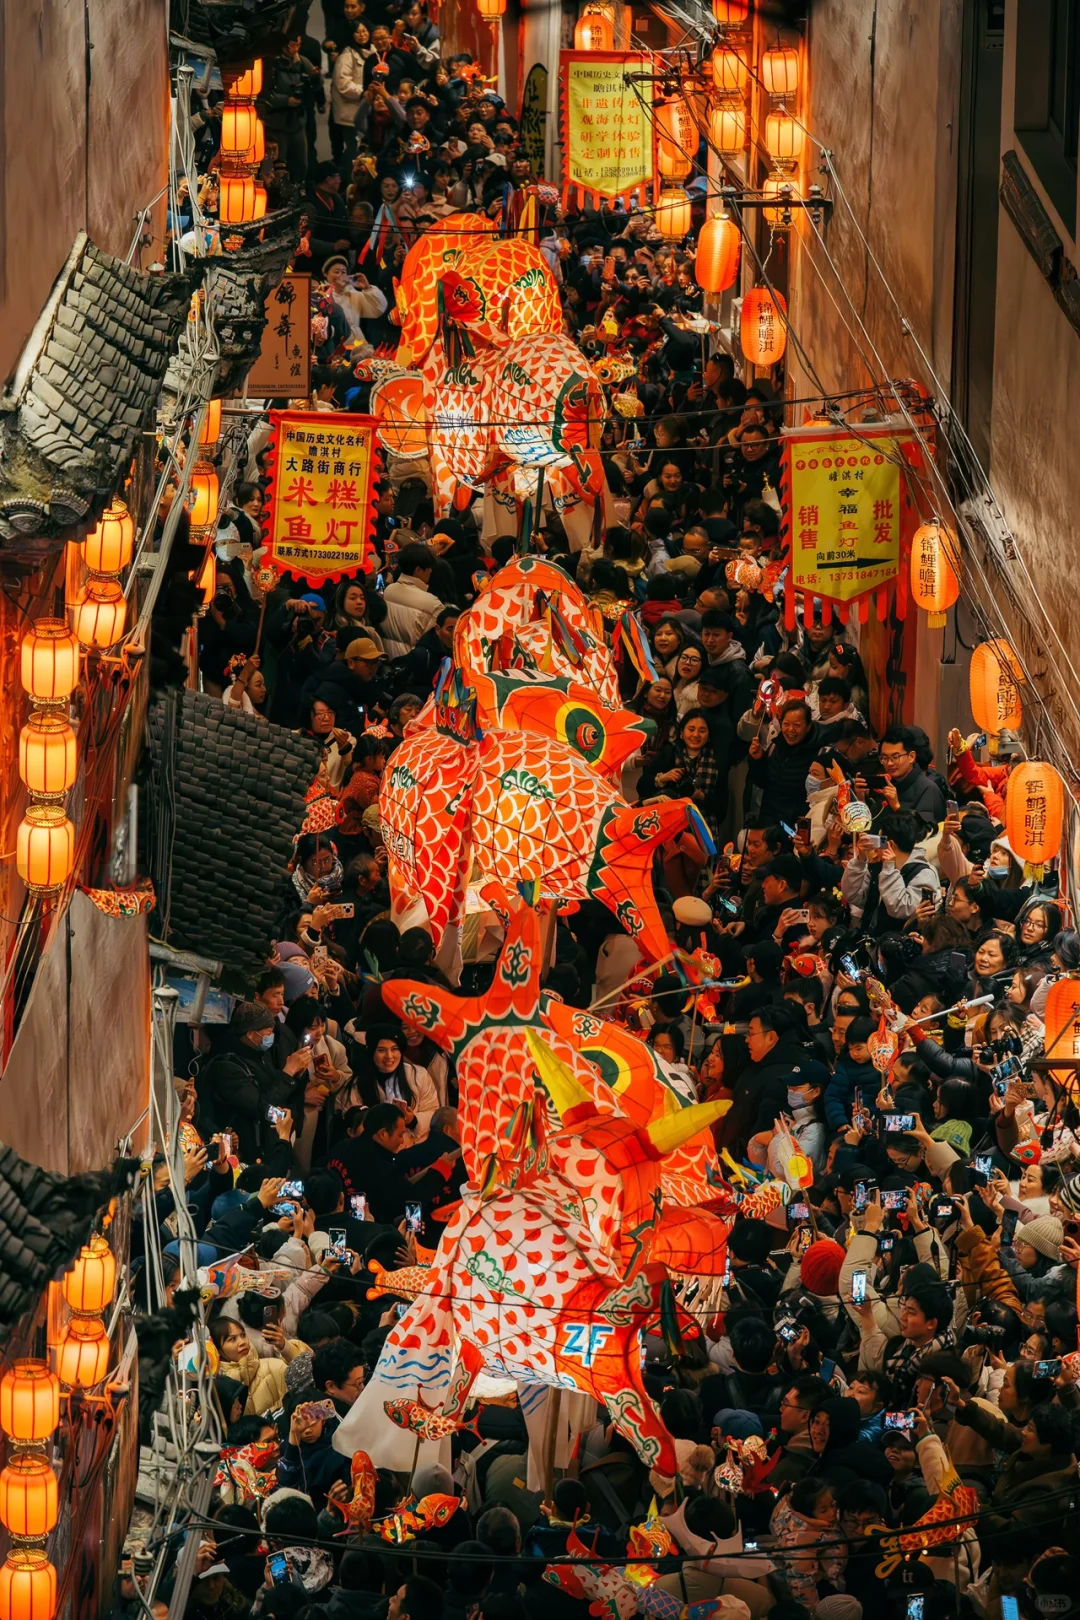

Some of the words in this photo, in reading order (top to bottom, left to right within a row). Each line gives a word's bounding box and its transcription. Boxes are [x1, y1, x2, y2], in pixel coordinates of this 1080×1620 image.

[590, 25, 603, 50] 锦鲤
[582, 97, 639, 109] 非遗传承
[581, 113, 640, 126] 观海鱼灯
[580, 131, 640, 143] 研学体验
[580, 147, 640, 160] 定制销售
[757, 301, 774, 352] 锦鲤瞻淇
[286, 430, 365, 447] 中国历史文化名村
[308, 446, 341, 458] 瞻淇村
[285, 457, 362, 477] 大路街商行
[796, 454, 895, 471] 中国历史文化名
[282, 476, 361, 511] 米糕
[797, 505, 820, 550] 销售
[872, 500, 894, 544] 批发
[280, 514, 359, 548] 鱼灯
[816, 550, 856, 561] 向前30米
[829, 567, 898, 583] 13731847184
[919, 537, 937, 598] 锦鲤瞻淇
